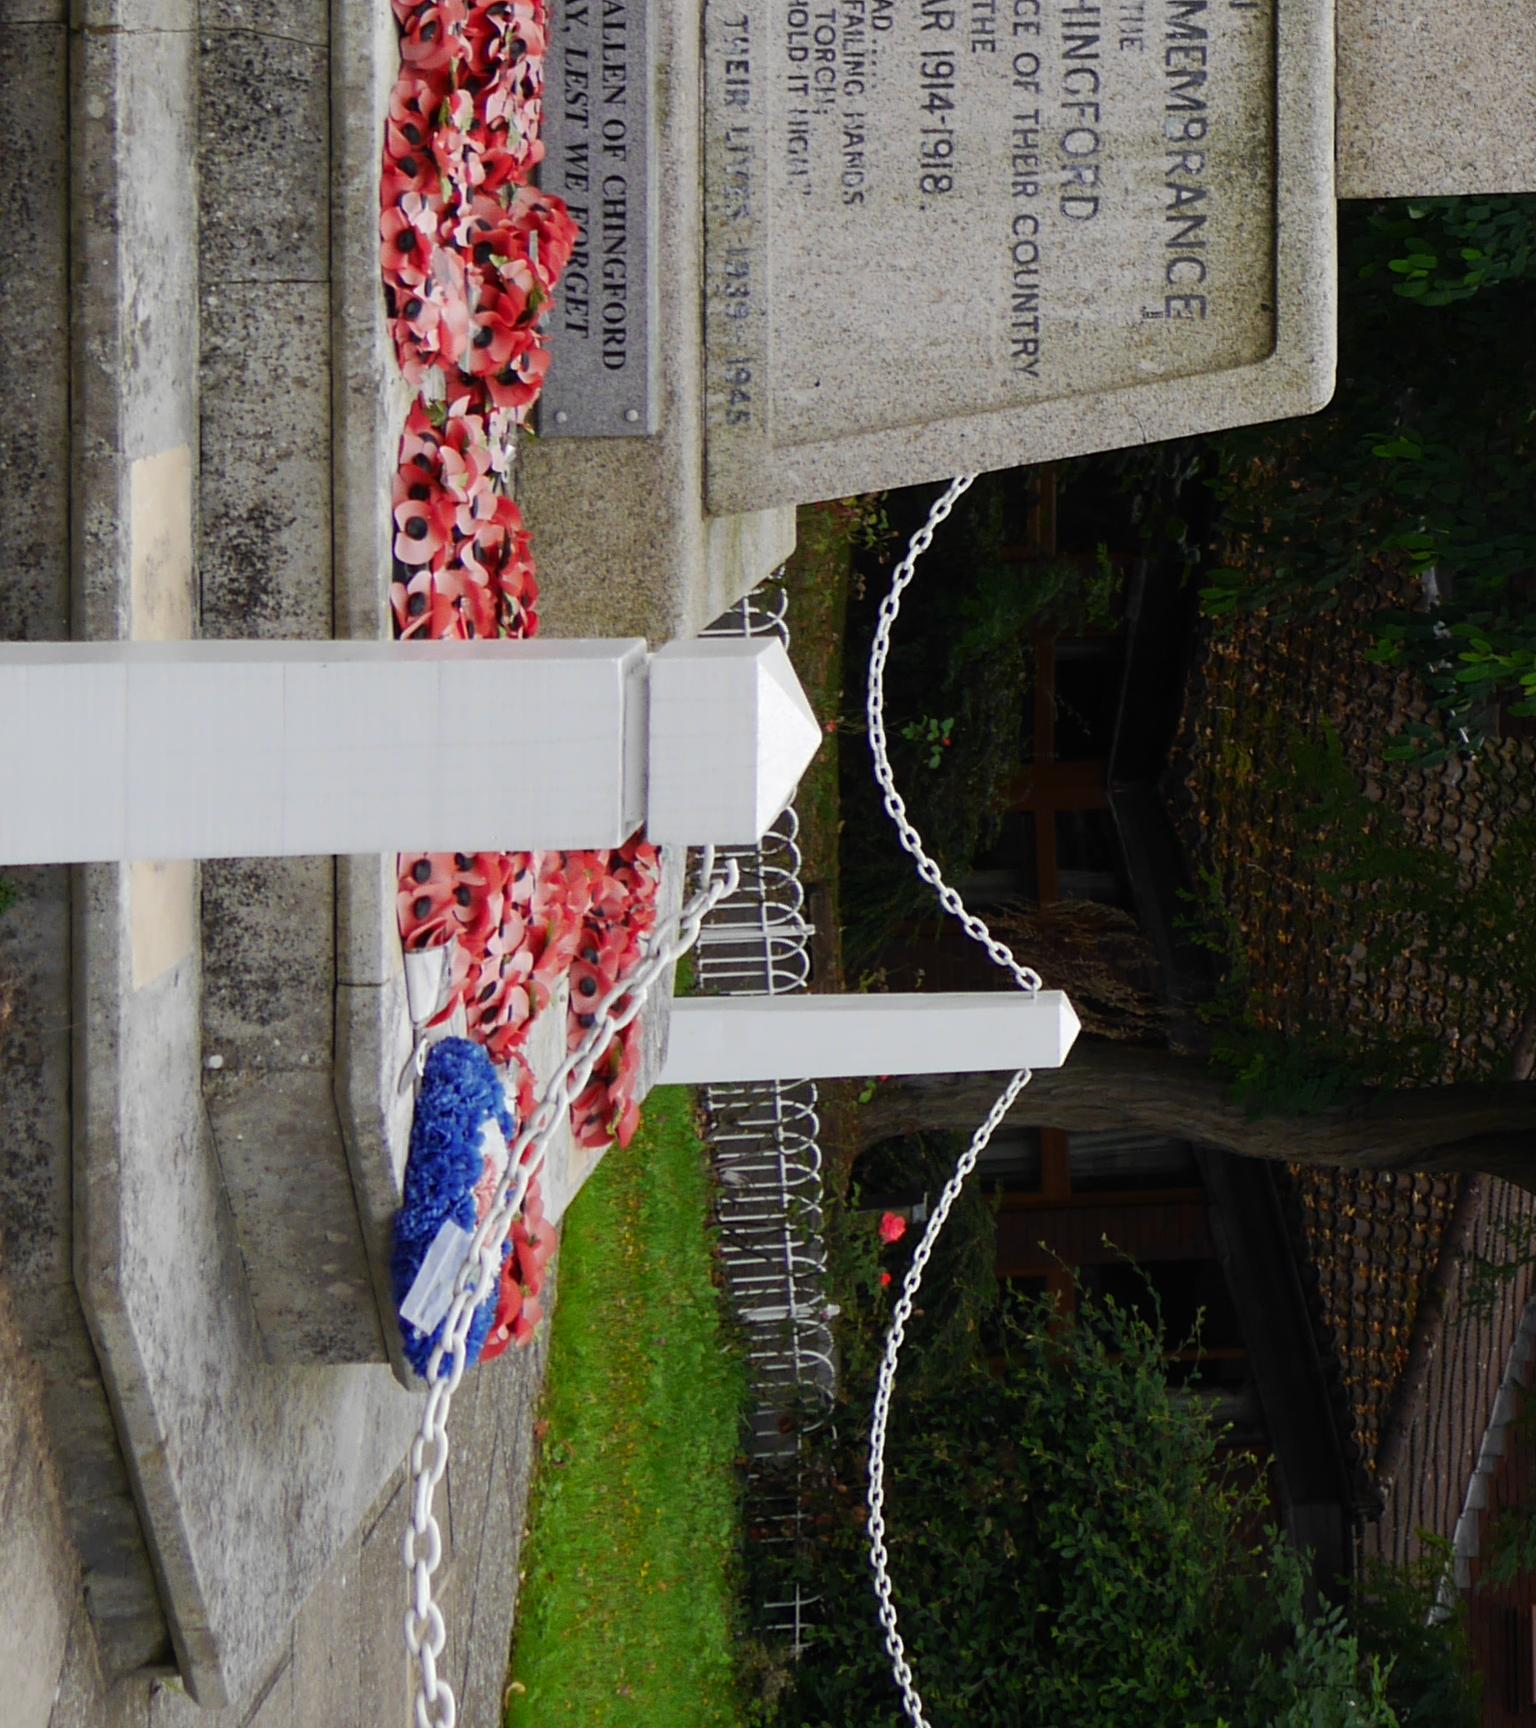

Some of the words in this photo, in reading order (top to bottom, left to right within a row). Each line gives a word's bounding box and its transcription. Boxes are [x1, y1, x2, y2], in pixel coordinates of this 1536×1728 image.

[724, 14, 750, 108] THEIR
[841, 0, 865, 97] FAILING
[1120, 2, 1146, 52] THE
[564, 46, 589, 129] LEST
[787, 75, 809, 97] IT
[1012, 52, 1040, 95] OF
[564, 142, 589, 192] WE
[602, 118, 627, 162] OF
[724, 126, 751, 223] LIVES
[841, 112, 865, 206] HANDS
[1011, 108, 1040, 198] THEIR
[564, 205, 590, 339] FORGET
[601, 174, 627, 372] CHINGFORD
[1011, 214, 1040, 378] COUNTRY
